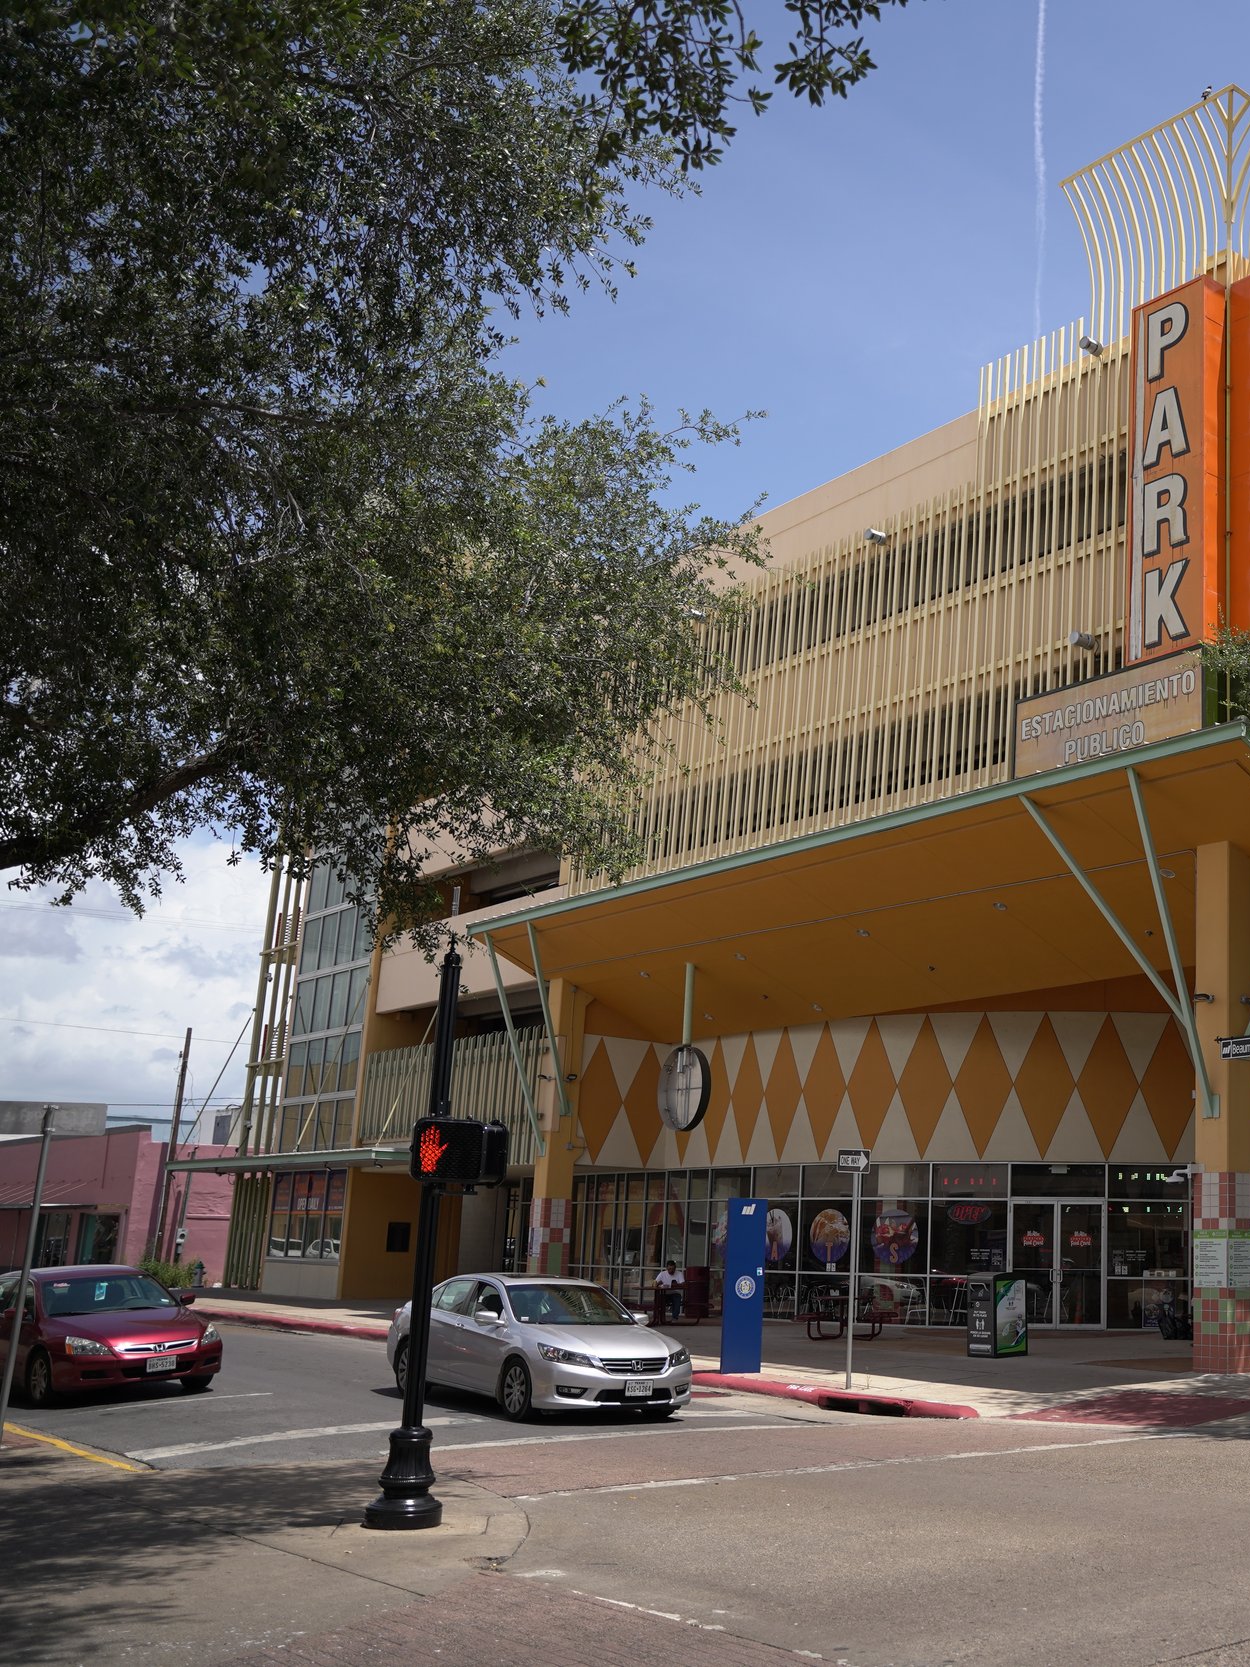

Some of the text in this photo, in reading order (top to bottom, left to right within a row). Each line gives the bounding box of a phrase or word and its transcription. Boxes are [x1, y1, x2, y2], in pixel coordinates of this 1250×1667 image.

[1142, 301, 1190, 649] PARK
[1021, 669, 1196, 742] ESTACIONAMIENTO
[1064, 720, 1145, 765] PUBLICO
[840, 1156, 860, 1166] ONE WAY
